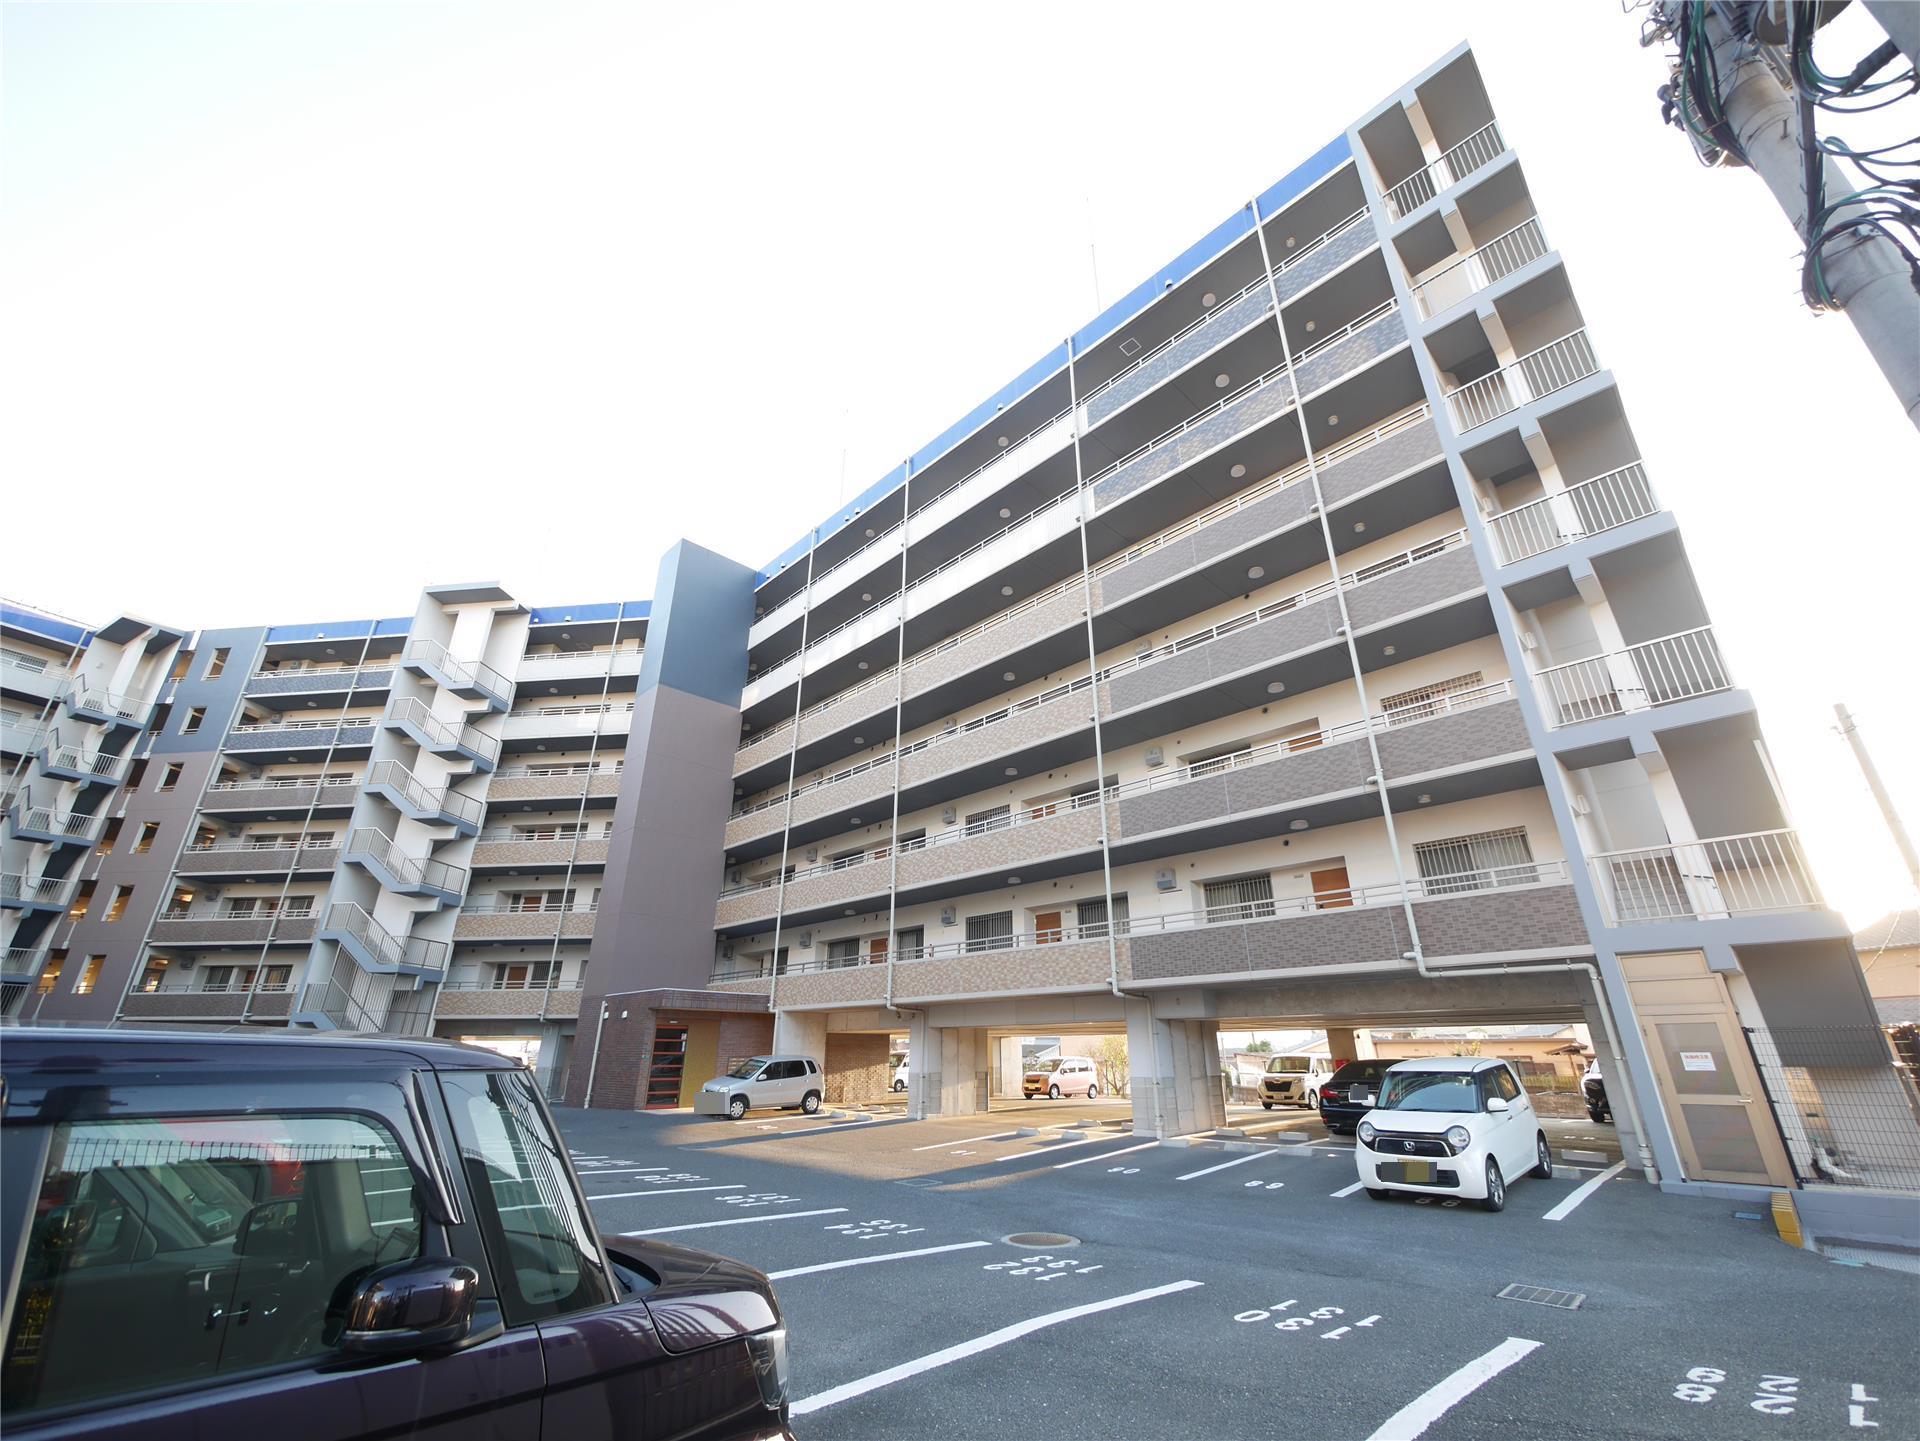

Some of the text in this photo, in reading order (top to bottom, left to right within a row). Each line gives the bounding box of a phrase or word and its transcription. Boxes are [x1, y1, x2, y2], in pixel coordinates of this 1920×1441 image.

[824, 1223, 889, 1240] 134
[860, 1219, 925, 1235] 135
[982, 1261, 1068, 1282] 132
[1020, 1255, 1104, 1274] 133
[1233, 1310, 1352, 1340] 130
[1270, 1299, 1383, 1327] 131
[1686, 1366, 1879, 1402] 129
[1672, 1383, 1879, 1427] 128
